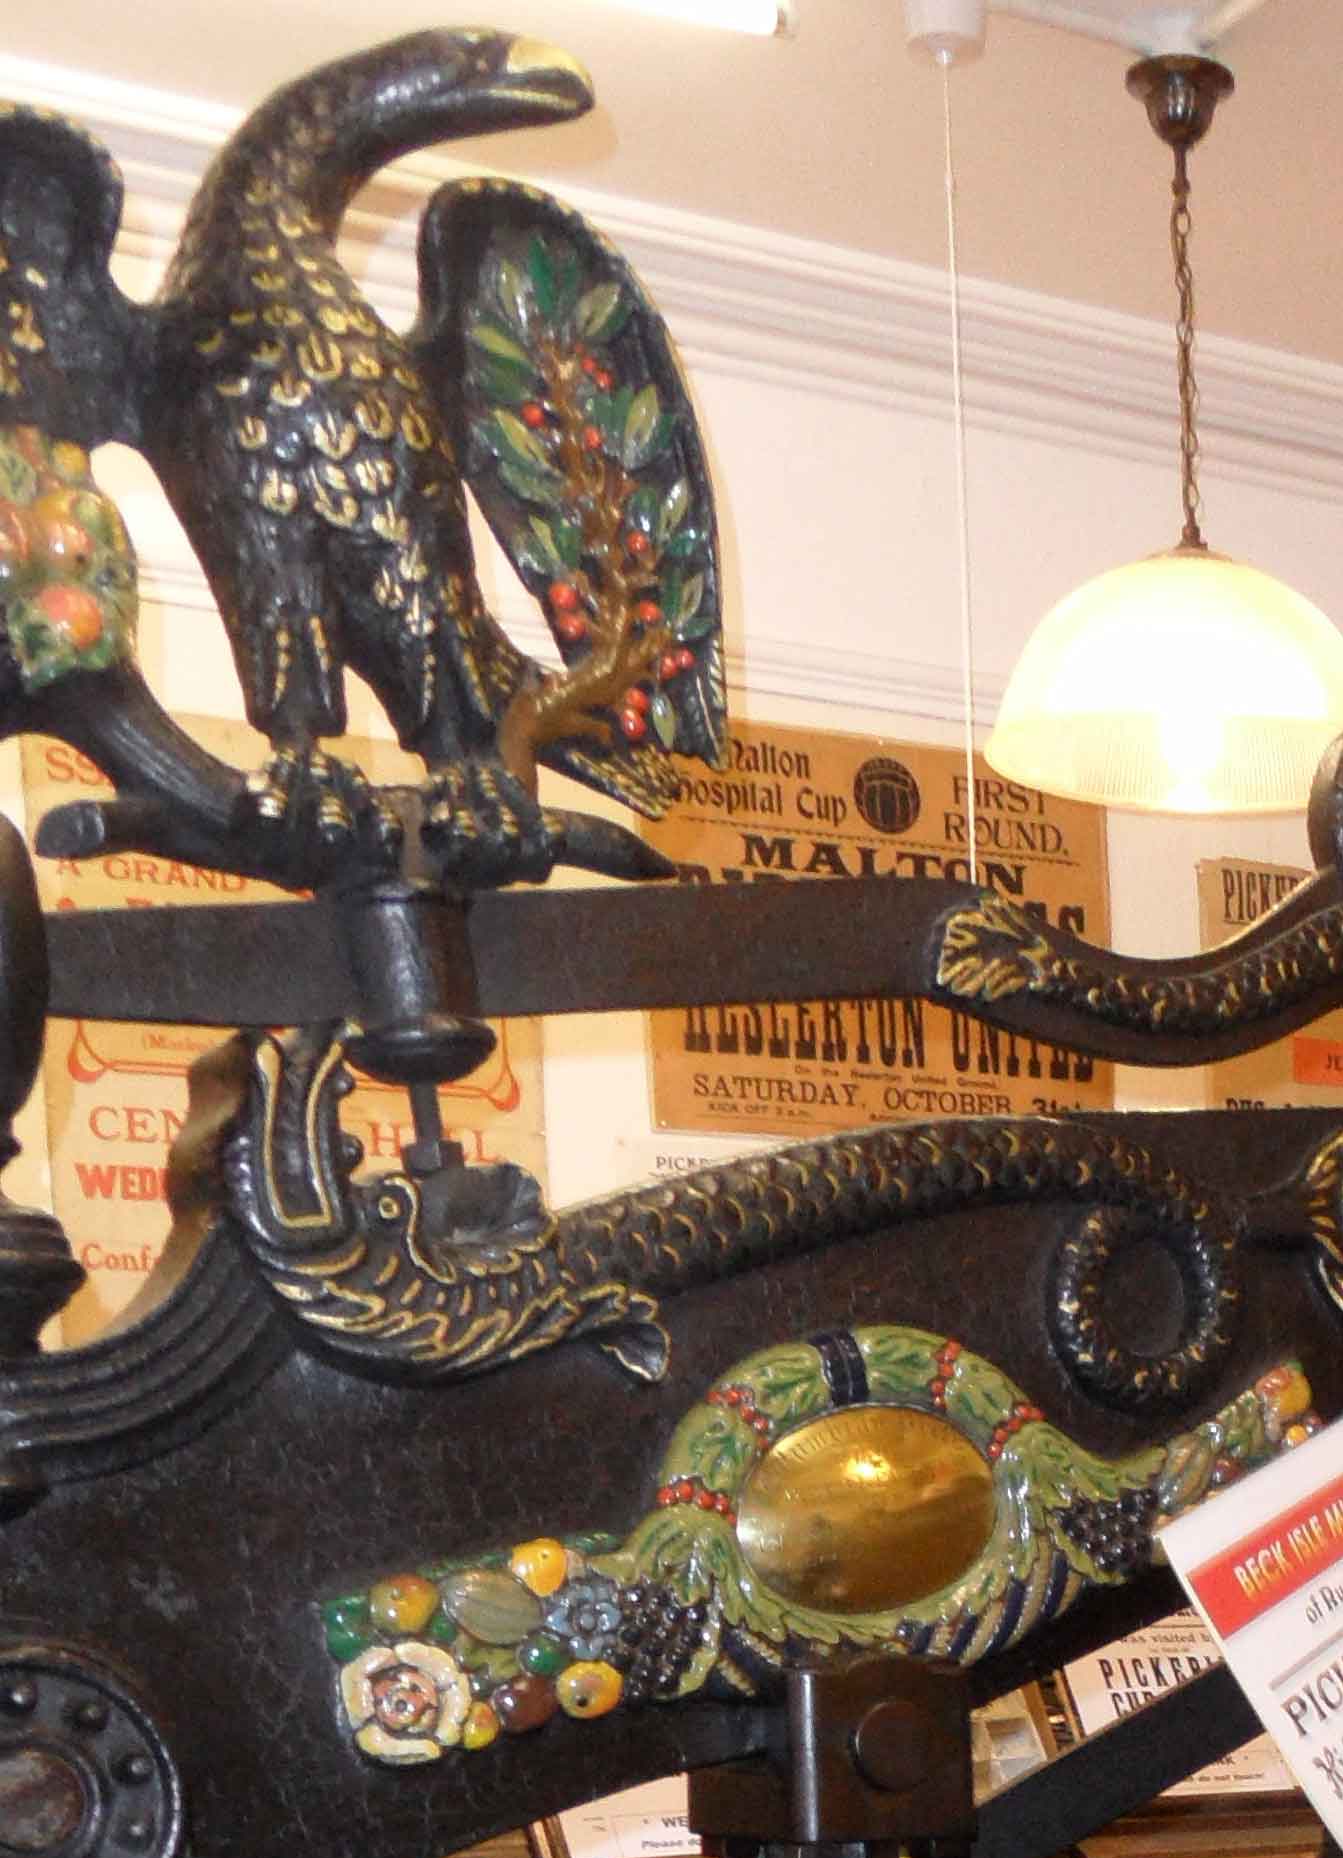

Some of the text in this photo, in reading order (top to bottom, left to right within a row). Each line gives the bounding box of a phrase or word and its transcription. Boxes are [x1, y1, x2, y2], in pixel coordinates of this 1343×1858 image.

[953, 775, 1047, 816] FIRST
[797, 786, 848, 828] Cup
[943, 812, 1070, 856] ROUND.
[102, 854, 249, 893] GRAND
[741, 833, 1027, 896] MALTON
[692, 1072, 867, 1110] SATURDAY,
[883, 1086, 1012, 1116] OCTOBER
[1233, 1540, 1289, 1600] BECK
[1288, 1513, 1329, 1566] ISLE
[1304, 1597, 1324, 1626] of
